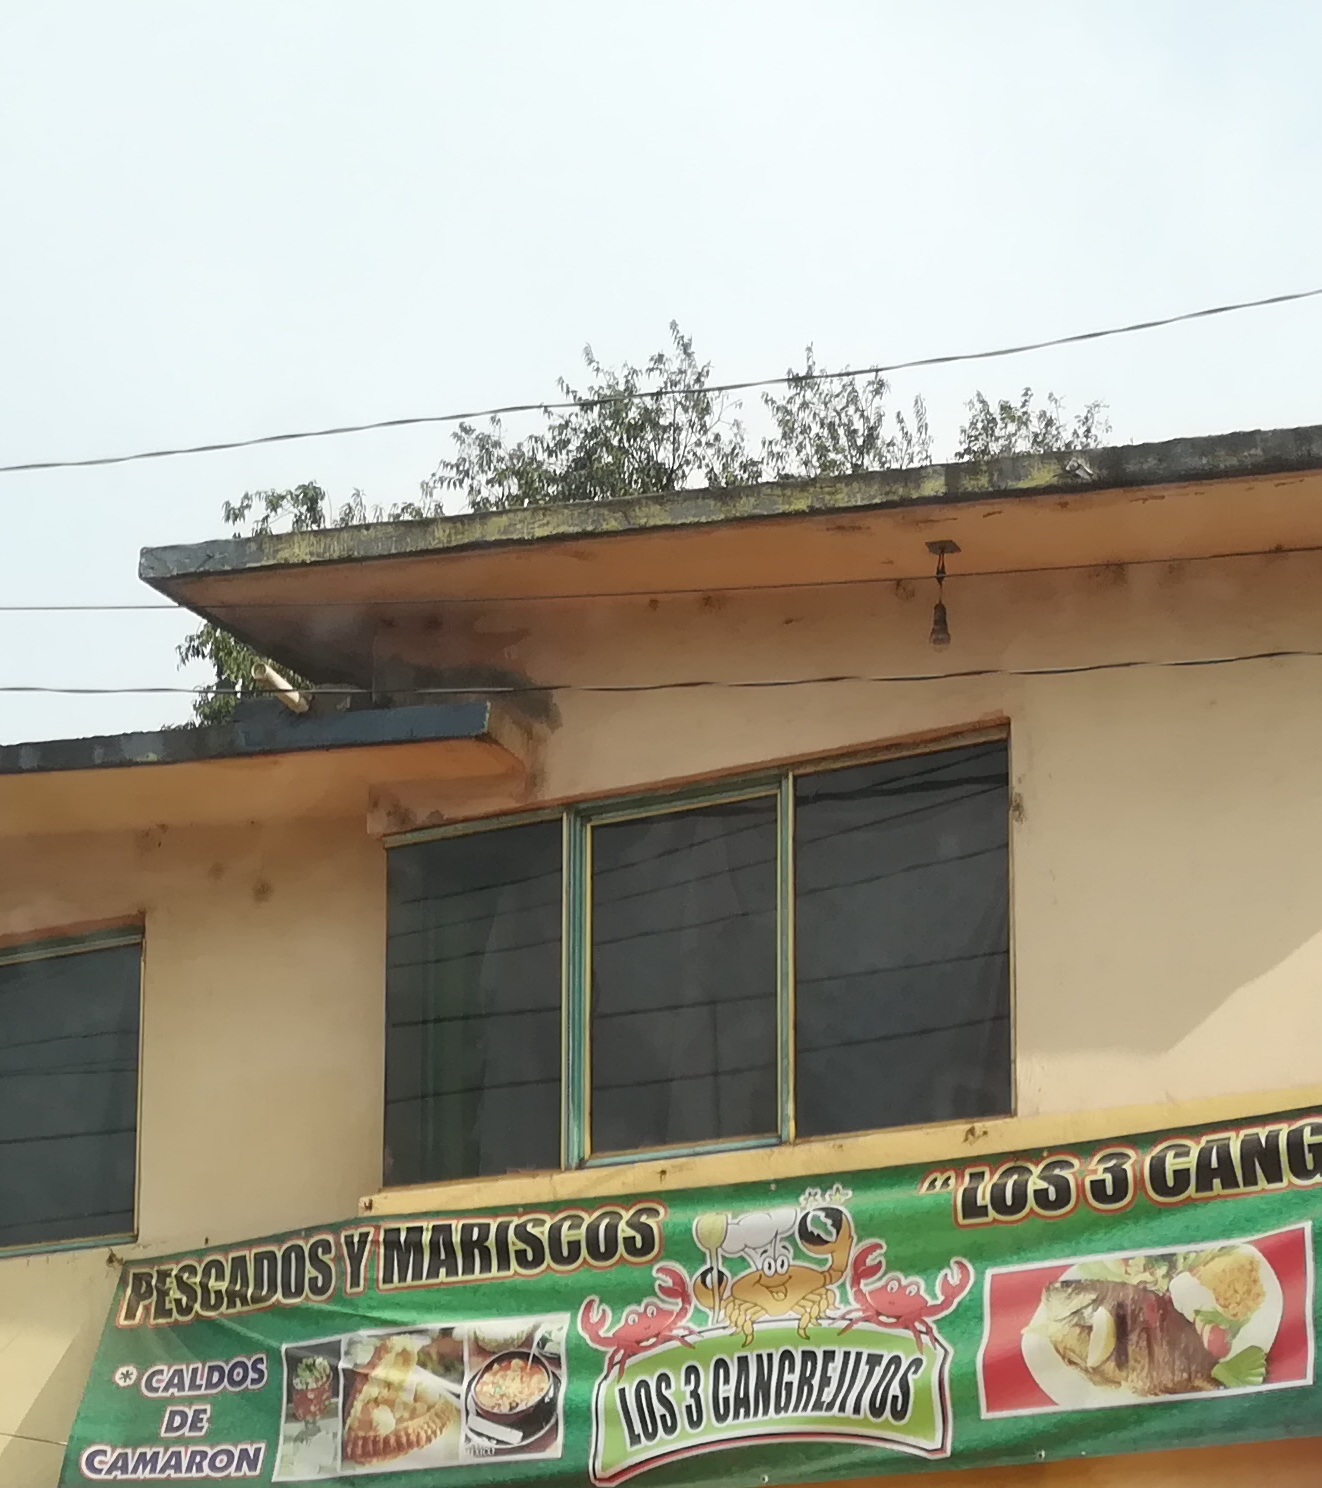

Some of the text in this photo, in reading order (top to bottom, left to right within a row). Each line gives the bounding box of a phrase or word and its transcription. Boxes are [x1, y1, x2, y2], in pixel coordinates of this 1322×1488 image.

[1087, 1149, 1136, 1208] 3
[119, 1205, 665, 1326] PESCADOS Y MARISCOS
[142, 1355, 267, 1396] CALDOS
[617, 1348, 925, 1448] LOS 3 CANGREJITOS
[162, 1405, 210, 1437] DE
[82, 1444, 265, 1479] CAMARON
